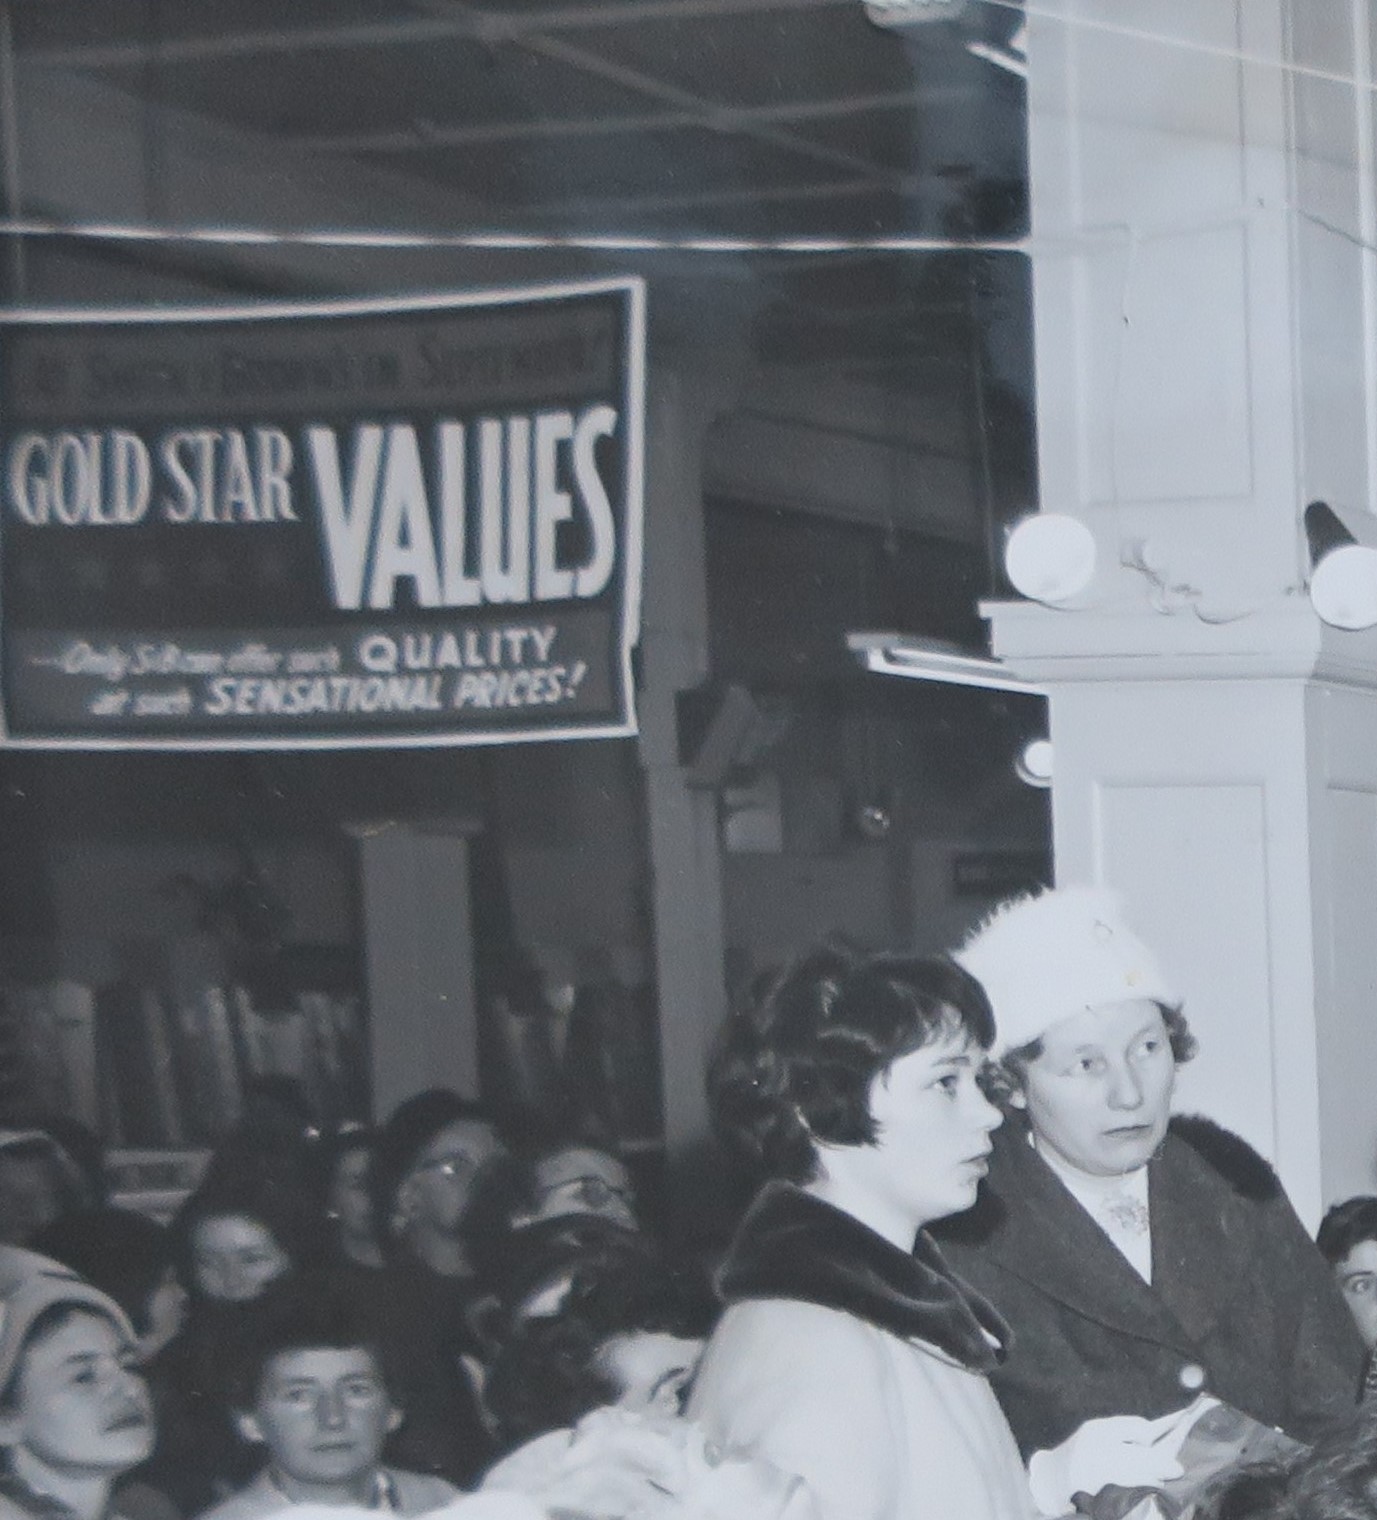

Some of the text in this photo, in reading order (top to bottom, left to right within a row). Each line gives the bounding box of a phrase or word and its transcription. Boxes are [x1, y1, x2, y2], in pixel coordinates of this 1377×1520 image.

[9, 404, 618, 611] GOLD STAR VALUES
[358, 625, 557, 673] QUALITY
[203, 672, 443, 717] SENSATIONAL
[453, 660, 588, 709] PRICES!
